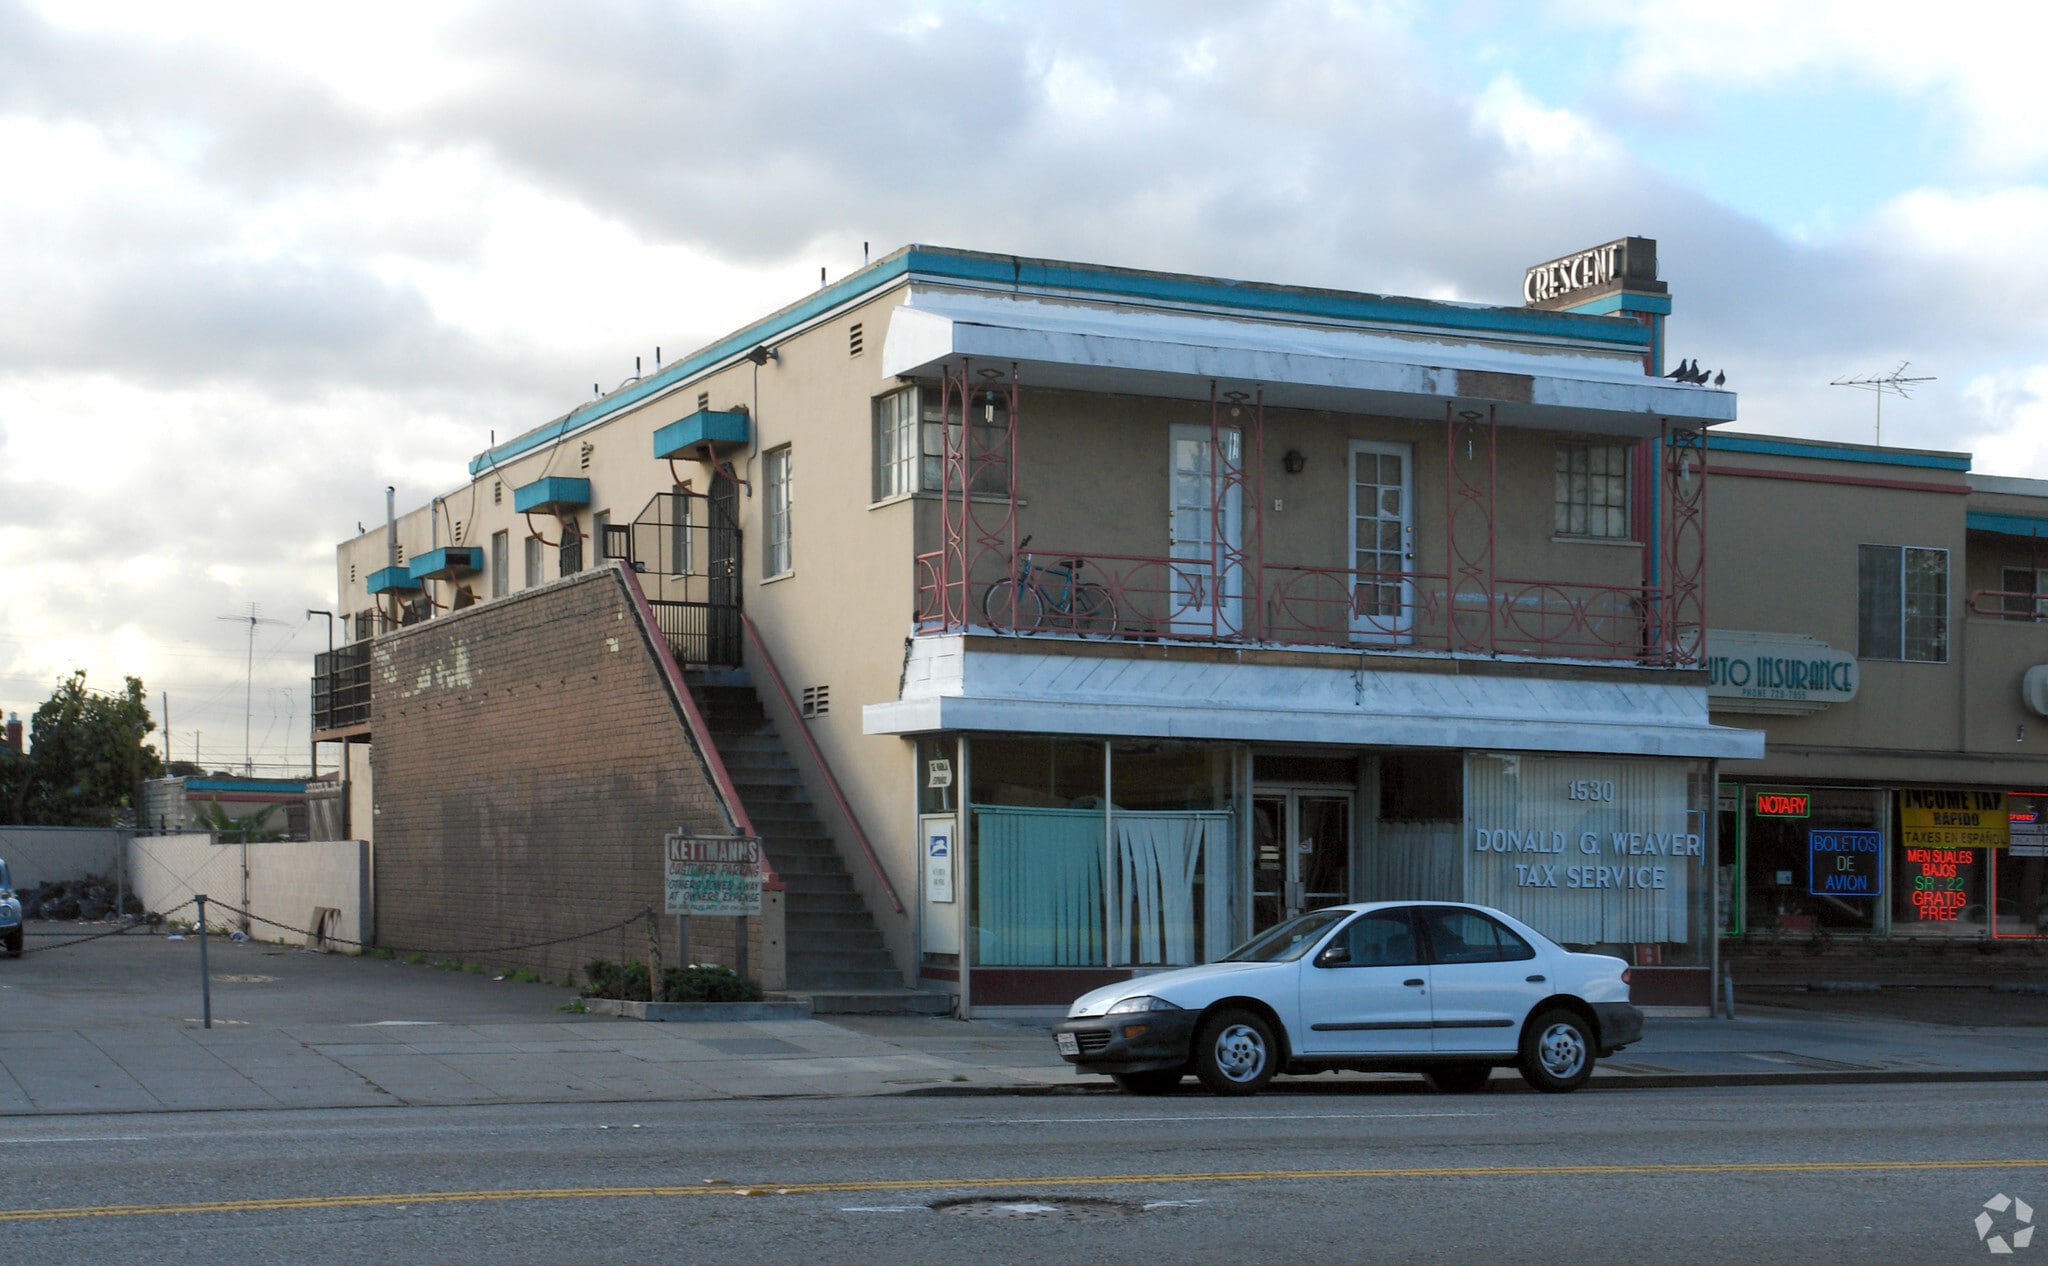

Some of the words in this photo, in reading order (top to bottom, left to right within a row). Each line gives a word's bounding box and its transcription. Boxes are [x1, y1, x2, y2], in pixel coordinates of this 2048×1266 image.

[1524, 245, 1618, 303] CRESCENT
[1757, 656, 1852, 692] INSURANCE
[1742, 688, 1767, 698] PHONE
[1568, 780, 1615, 801] 1530
[1758, 796, 1807, 814] NOTARY
[1905, 790, 1968, 809] INCOME
[1974, 791, 2002, 810] TAX
[1475, 828, 1567, 854] DONALD
[1580, 831, 1600, 855] G.
[1610, 832, 1700, 857] WEAVER
[1814, 835, 1878, 852] BOLETOS
[1905, 831, 1941, 844] TAXES
[1945, 832, 1958, 844] EN
[1837, 855, 1855, 872] DE
[1922, 863, 1957, 878] BAJOS
[1515, 864, 1557, 888] TAX
[1566, 864, 1665, 889] SERVICE
[1825, 873, 1868, 891] AVION
[1912, 891, 1967, 907] GRATIS
[1919, 906, 1958, 921] FREE
